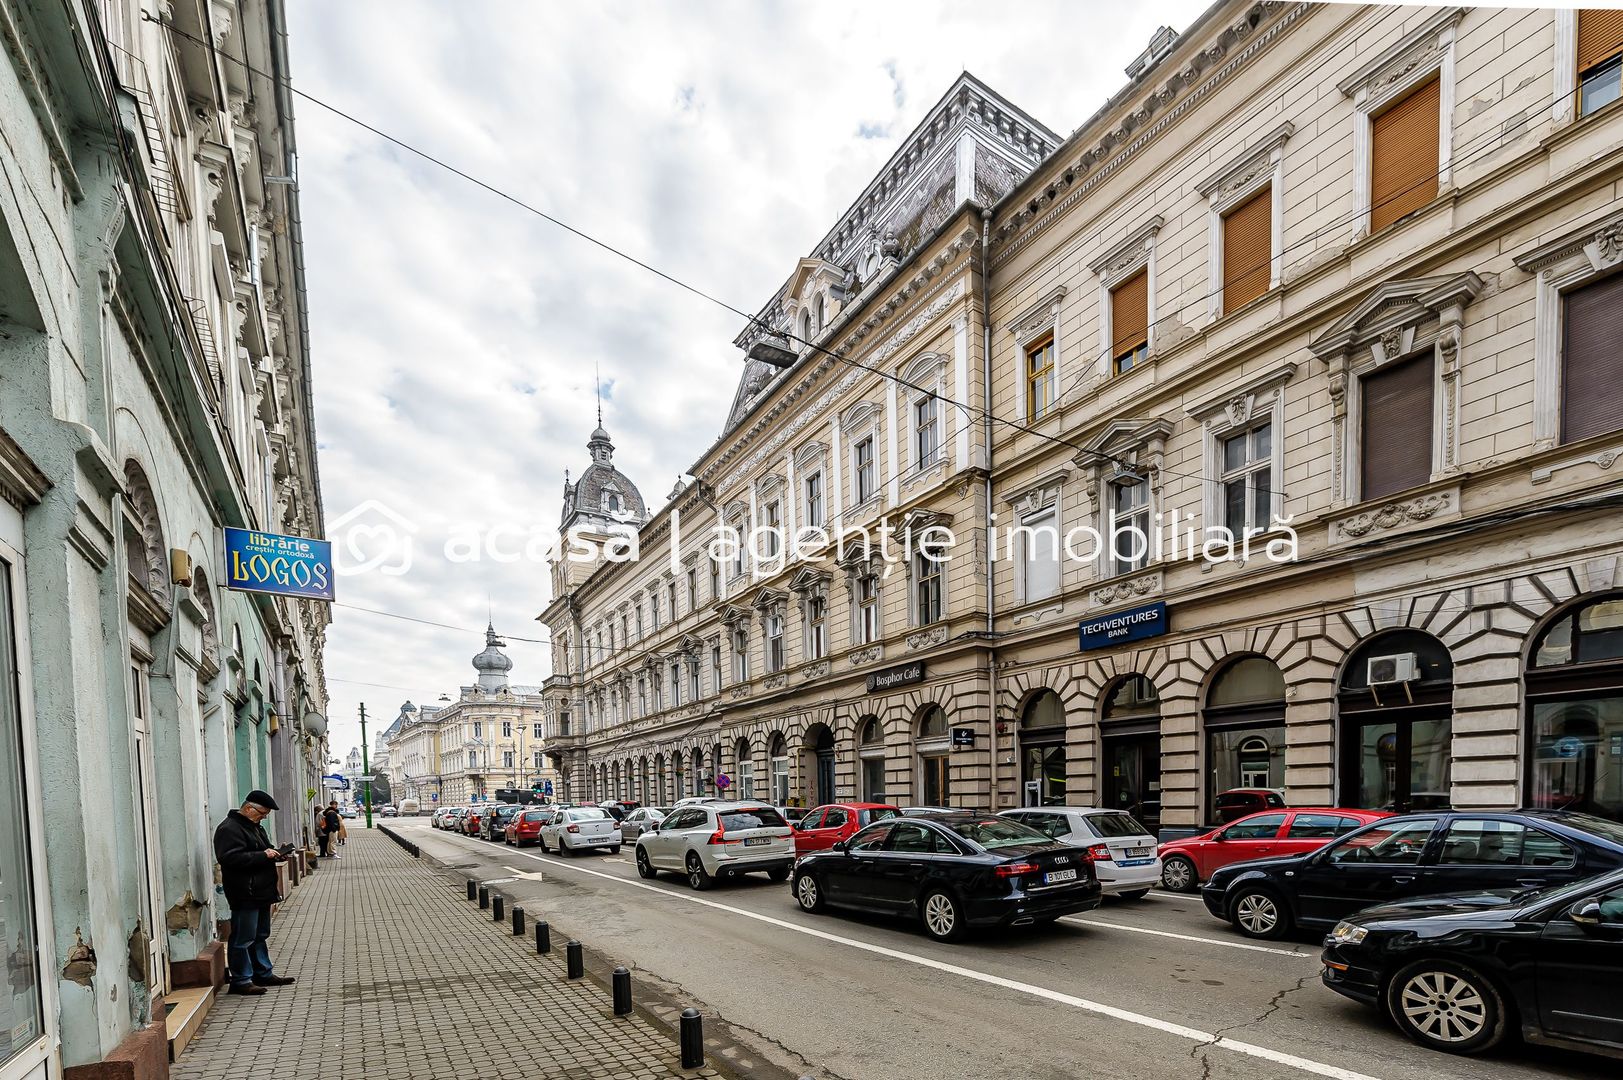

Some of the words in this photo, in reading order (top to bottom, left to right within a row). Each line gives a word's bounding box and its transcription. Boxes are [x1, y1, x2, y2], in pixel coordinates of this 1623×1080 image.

[249, 533, 309, 551] librărie
[277, 549, 315, 560] ortodoxă
[232, 551, 328, 590] LOGOS
[1081, 609, 1158, 635] TECHVENTURES
[1107, 627, 1128, 638] BANK
[876, 673, 903, 686] Bosphor
[903, 667, 920, 679] Cafe
